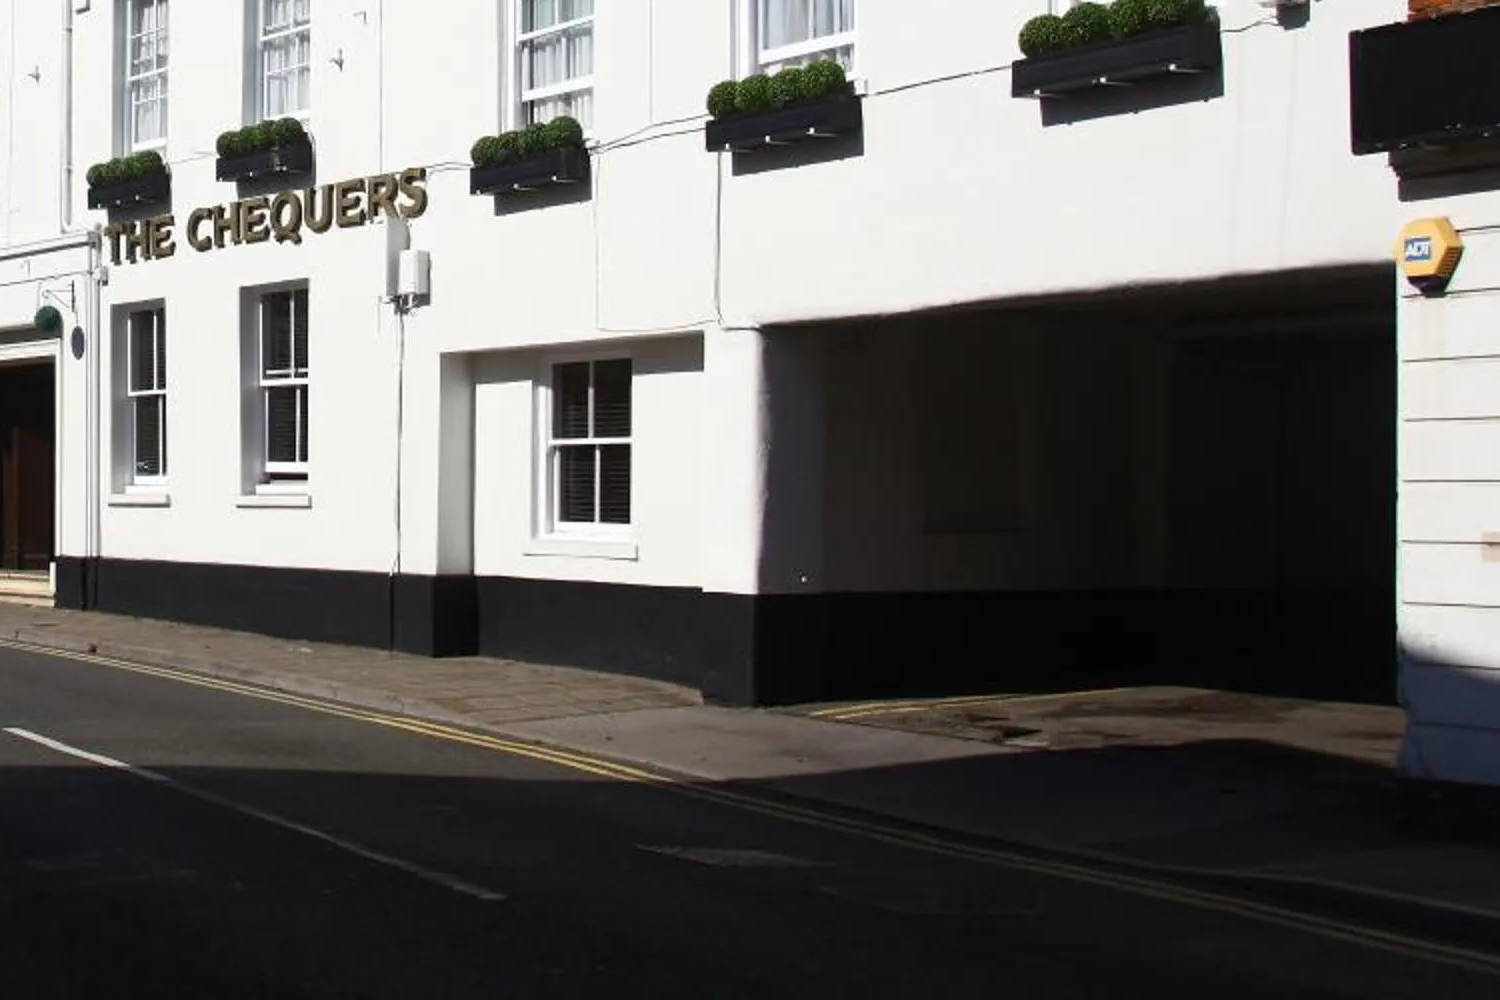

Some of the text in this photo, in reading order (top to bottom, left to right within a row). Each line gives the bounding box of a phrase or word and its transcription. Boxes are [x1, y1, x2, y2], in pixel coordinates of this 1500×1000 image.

[104, 168, 429, 266] THE CHEQUERS
[1404, 240, 1430, 258] ADT
